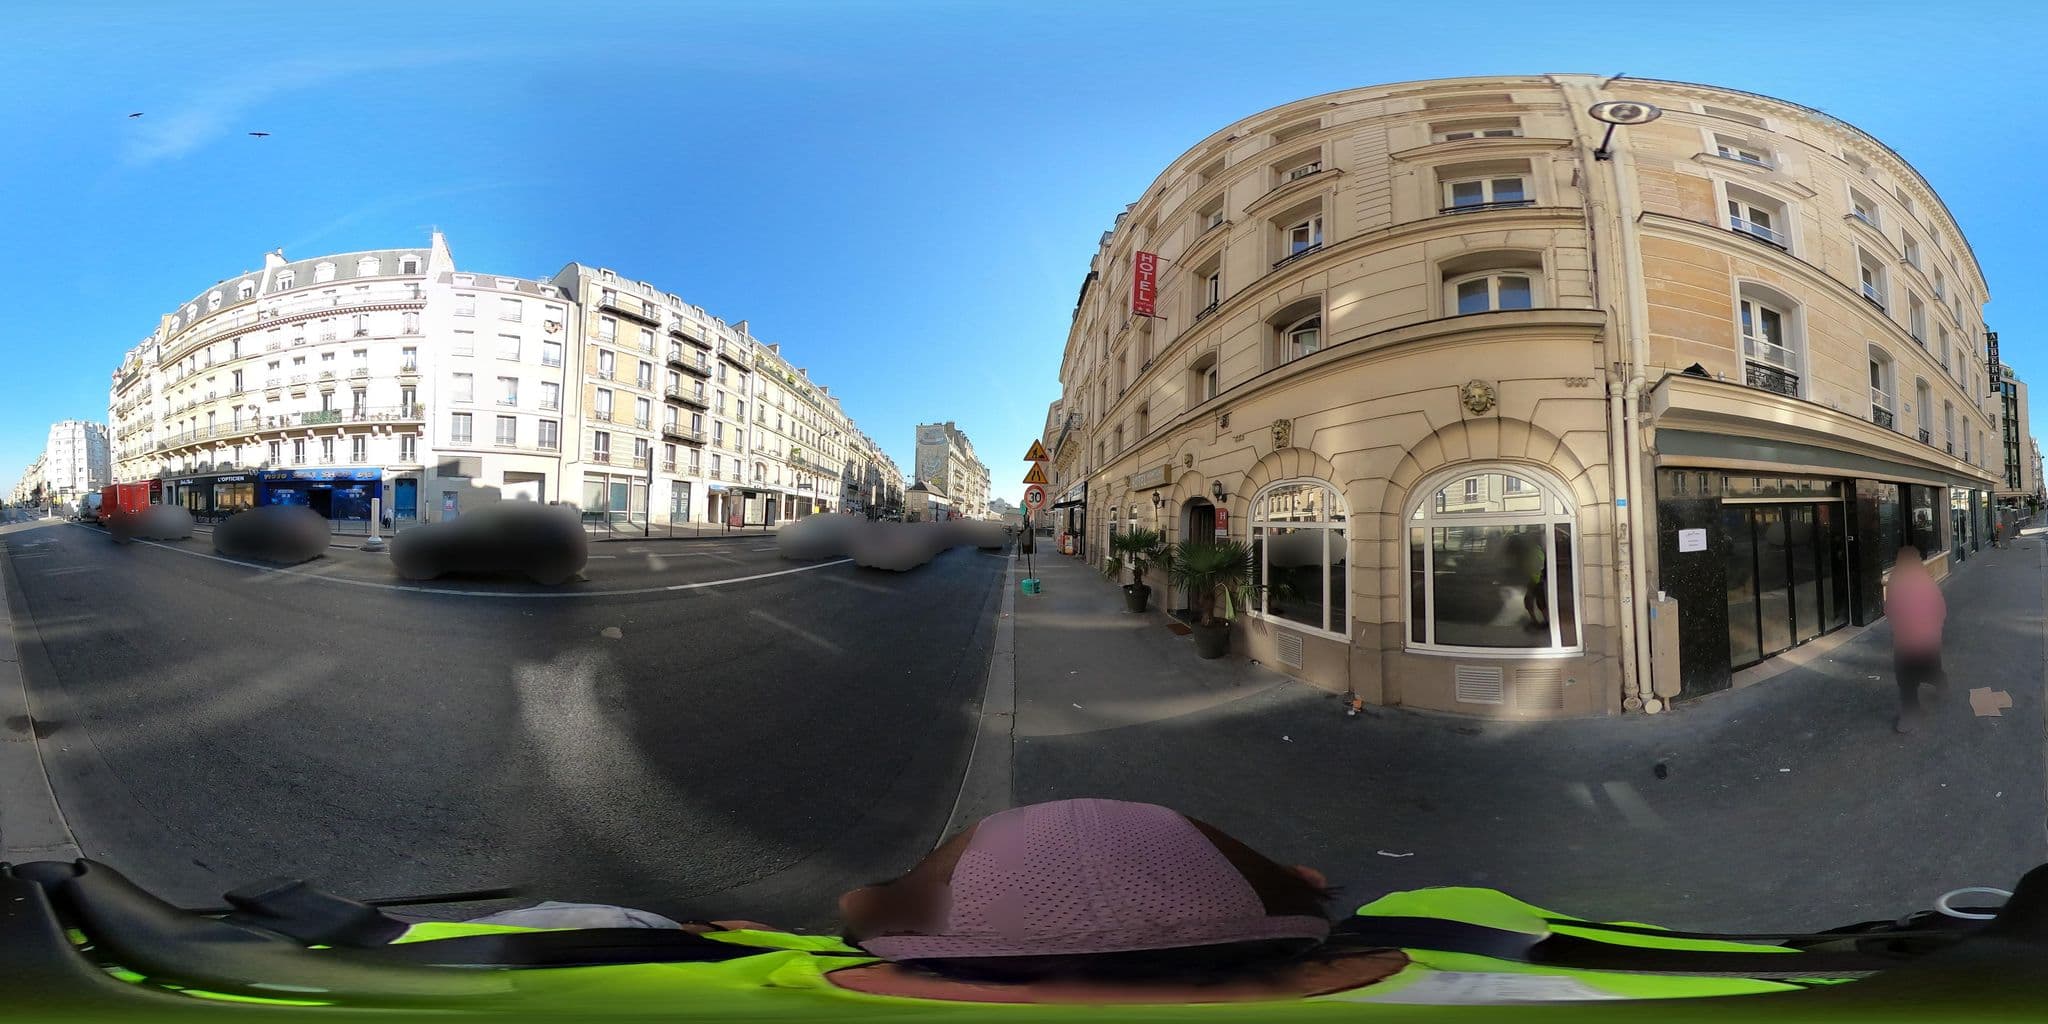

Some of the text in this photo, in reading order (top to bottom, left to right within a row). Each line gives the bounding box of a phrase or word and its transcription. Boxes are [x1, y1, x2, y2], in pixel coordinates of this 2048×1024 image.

[1139, 253, 1154, 302] HOTEL
[217, 475, 245, 483] L'OPTICIEN
[1029, 492, 1042, 503] 30
[1220, 512, 1226, 520] H
